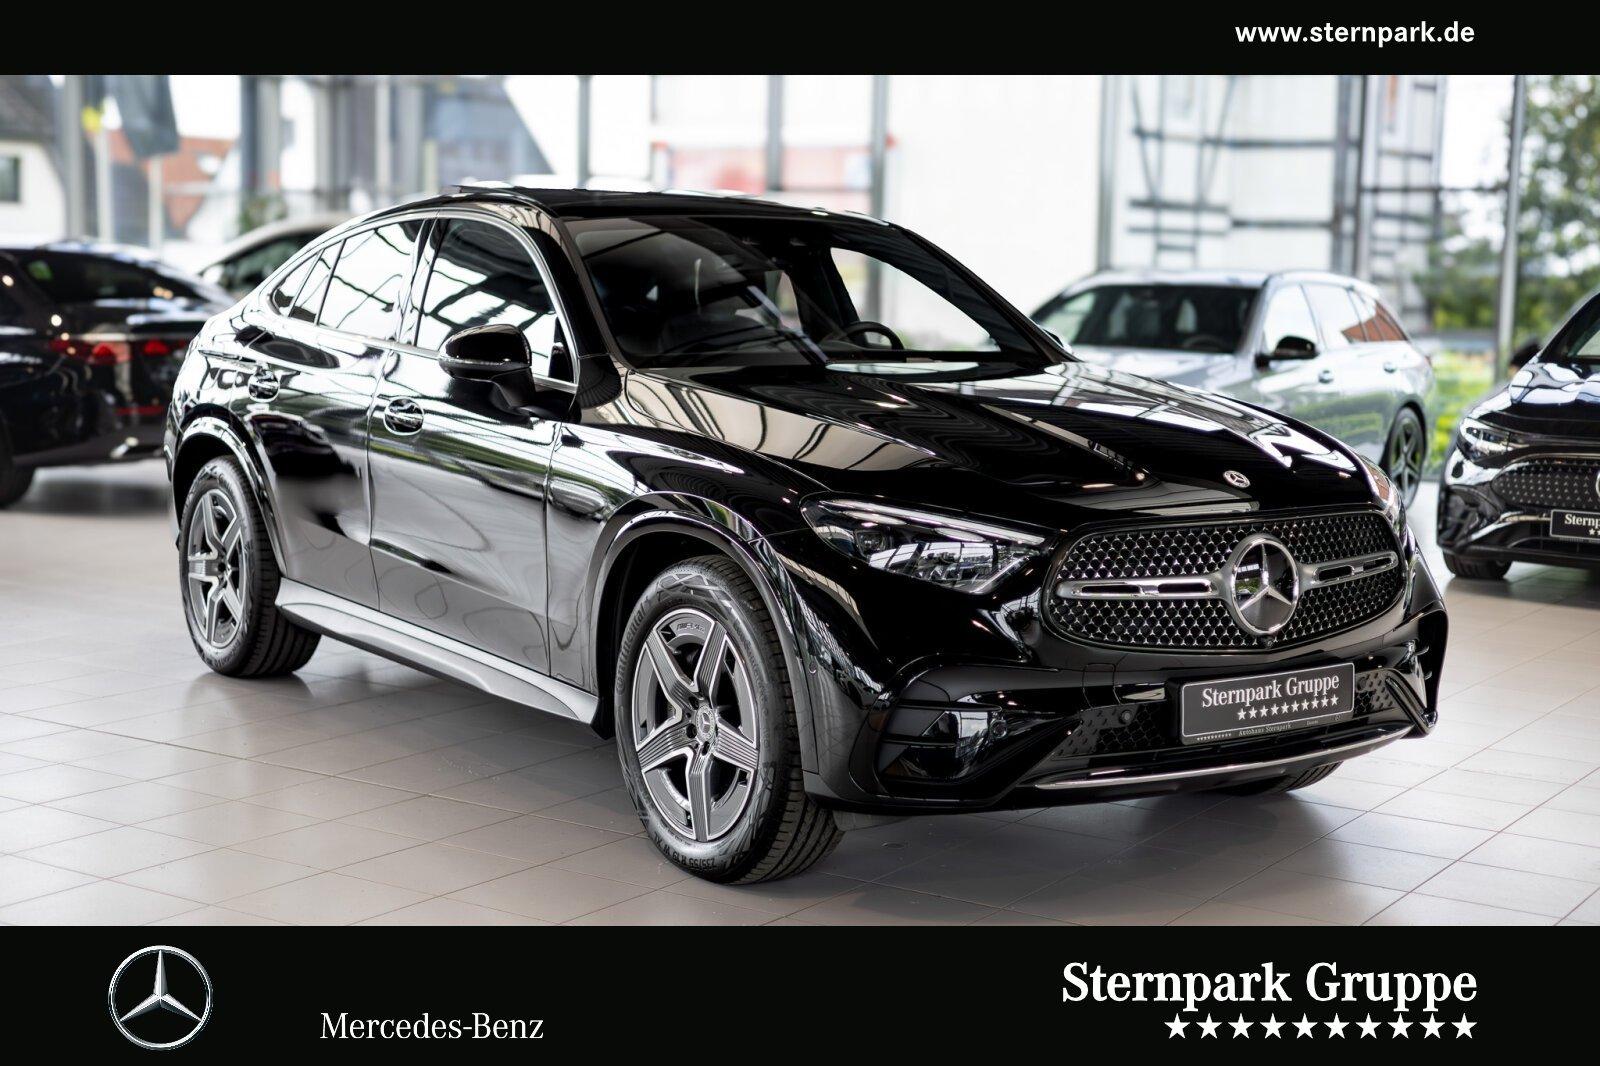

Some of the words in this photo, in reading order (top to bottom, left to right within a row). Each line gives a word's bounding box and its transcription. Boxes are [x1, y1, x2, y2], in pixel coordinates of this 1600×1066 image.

[616, 602, 647, 696] Continental
[1202, 679, 1283, 708] Sternpark
[1286, 675, 1340, 697] Gruppe
[1238, 727, 1265, 737] Autohaus
[1265, 723, 1292, 734] Sternpark
